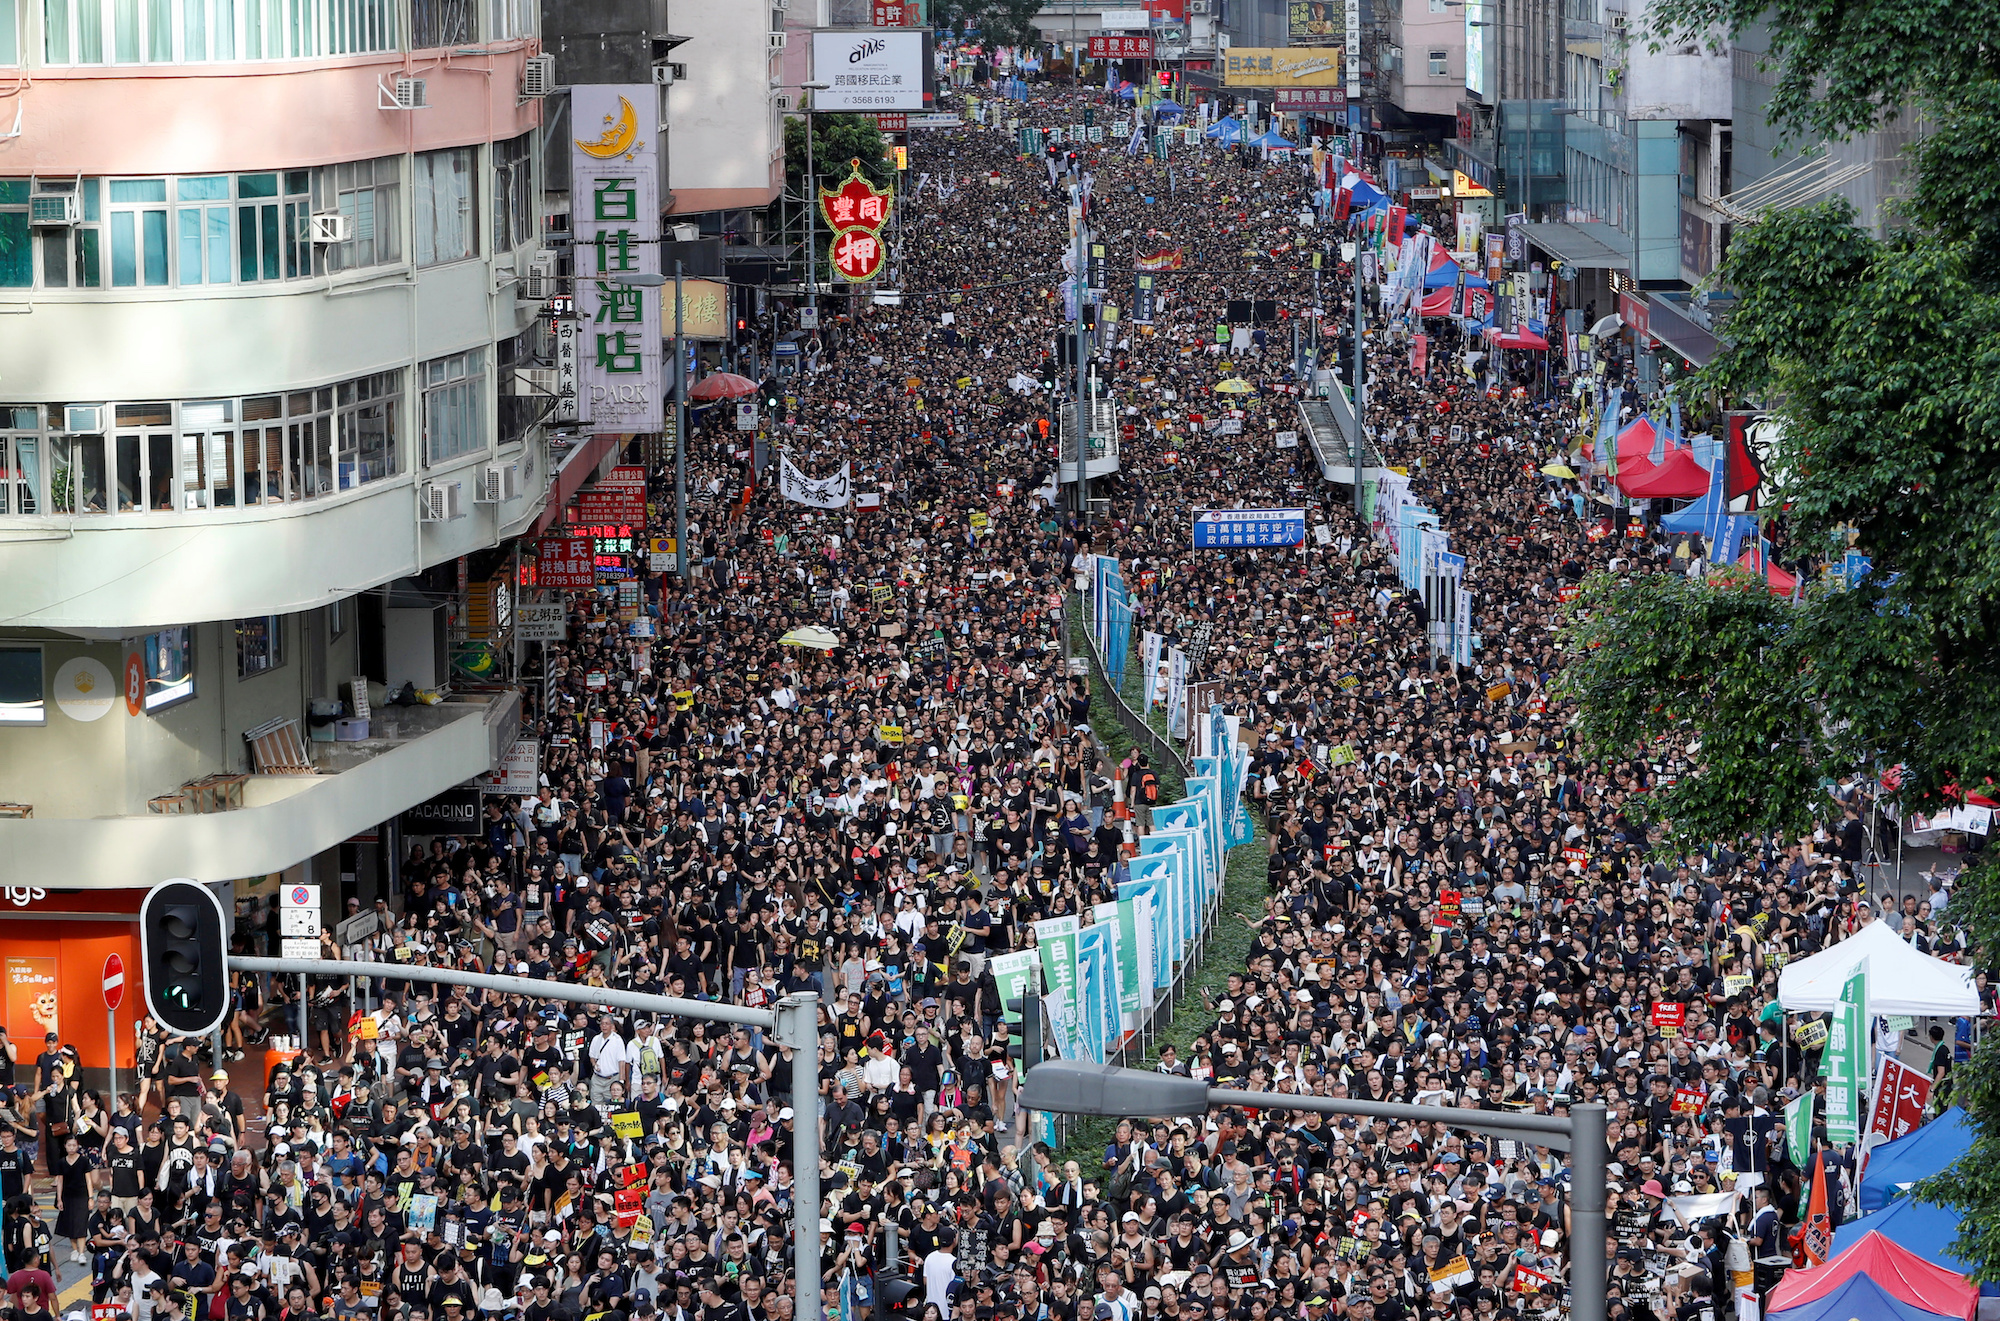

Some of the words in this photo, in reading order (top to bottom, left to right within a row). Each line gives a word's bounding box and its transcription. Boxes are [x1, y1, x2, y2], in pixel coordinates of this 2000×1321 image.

[886, 6, 902, 26] 許
[1094, 39, 1149, 51] 港豐找換
[1228, 56, 1273, 71] 日本城
[1275, 57, 1329, 77] Superstore
[835, 75, 902, 86] 跨國移民企業
[852, 96, 872, 104] 3568
[874, 96, 895, 104] 6193
[1277, 91, 1344, 102] 潮興魚蛋粉
[836, 234, 877, 275] 押
[593, 177, 643, 374] 百佳酒店
[661, 291, 721, 325] 瓊樓
[590, 384, 647, 403] PARK
[782, 464, 847, 504] 警察暴力
[1206, 522, 1295, 534] 百萬群眾抗逆行
[1206, 533, 1295, 545] 政府無視不是人
[543, 541, 587, 558] 許氏
[540, 561, 591, 574] 找換匯款
[571, 576, 592, 585] 1968
[408, 805, 475, 818] FACACINO
[306, 911, 313, 919] 7
[307, 925, 314, 934] 8
[1726, 979, 1742, 987] STAND
[1726, 986, 1739, 995] FOR
[1658, 1004, 1677, 1012] FREE
[404, 1274, 422, 1282] JUST
